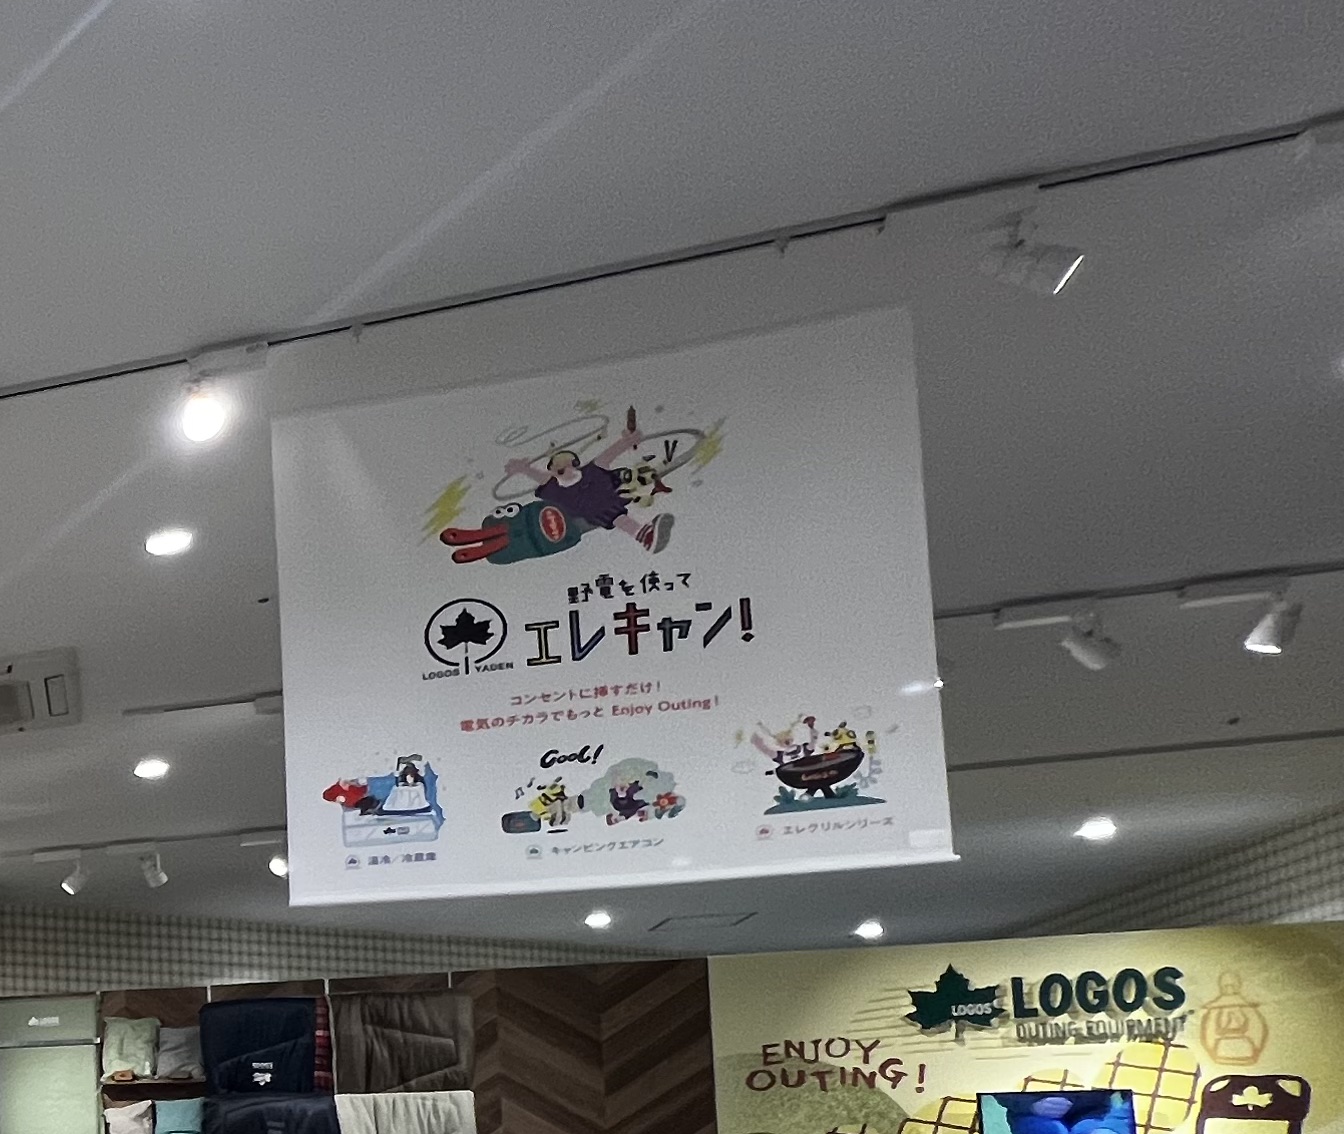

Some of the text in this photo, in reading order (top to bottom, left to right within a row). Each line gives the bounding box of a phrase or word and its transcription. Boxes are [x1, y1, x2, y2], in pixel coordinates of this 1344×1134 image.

[567, 571, 691, 604] 野電を使って
[524, 597, 755, 667] エレキャン!
[421, 662, 514, 681] LOGOS YADEN
[460, 696, 720, 733] 電気のチカラでもっと Enjoy Outing!
[1011, 966, 1186, 1018] LOGOS
[951, 1002, 993, 1017] LOGOS
[1015, 1020, 1079, 1041] OUTING
[761, 1037, 881, 1066] ENJOY
[745, 1058, 926, 1093] OUTING!
